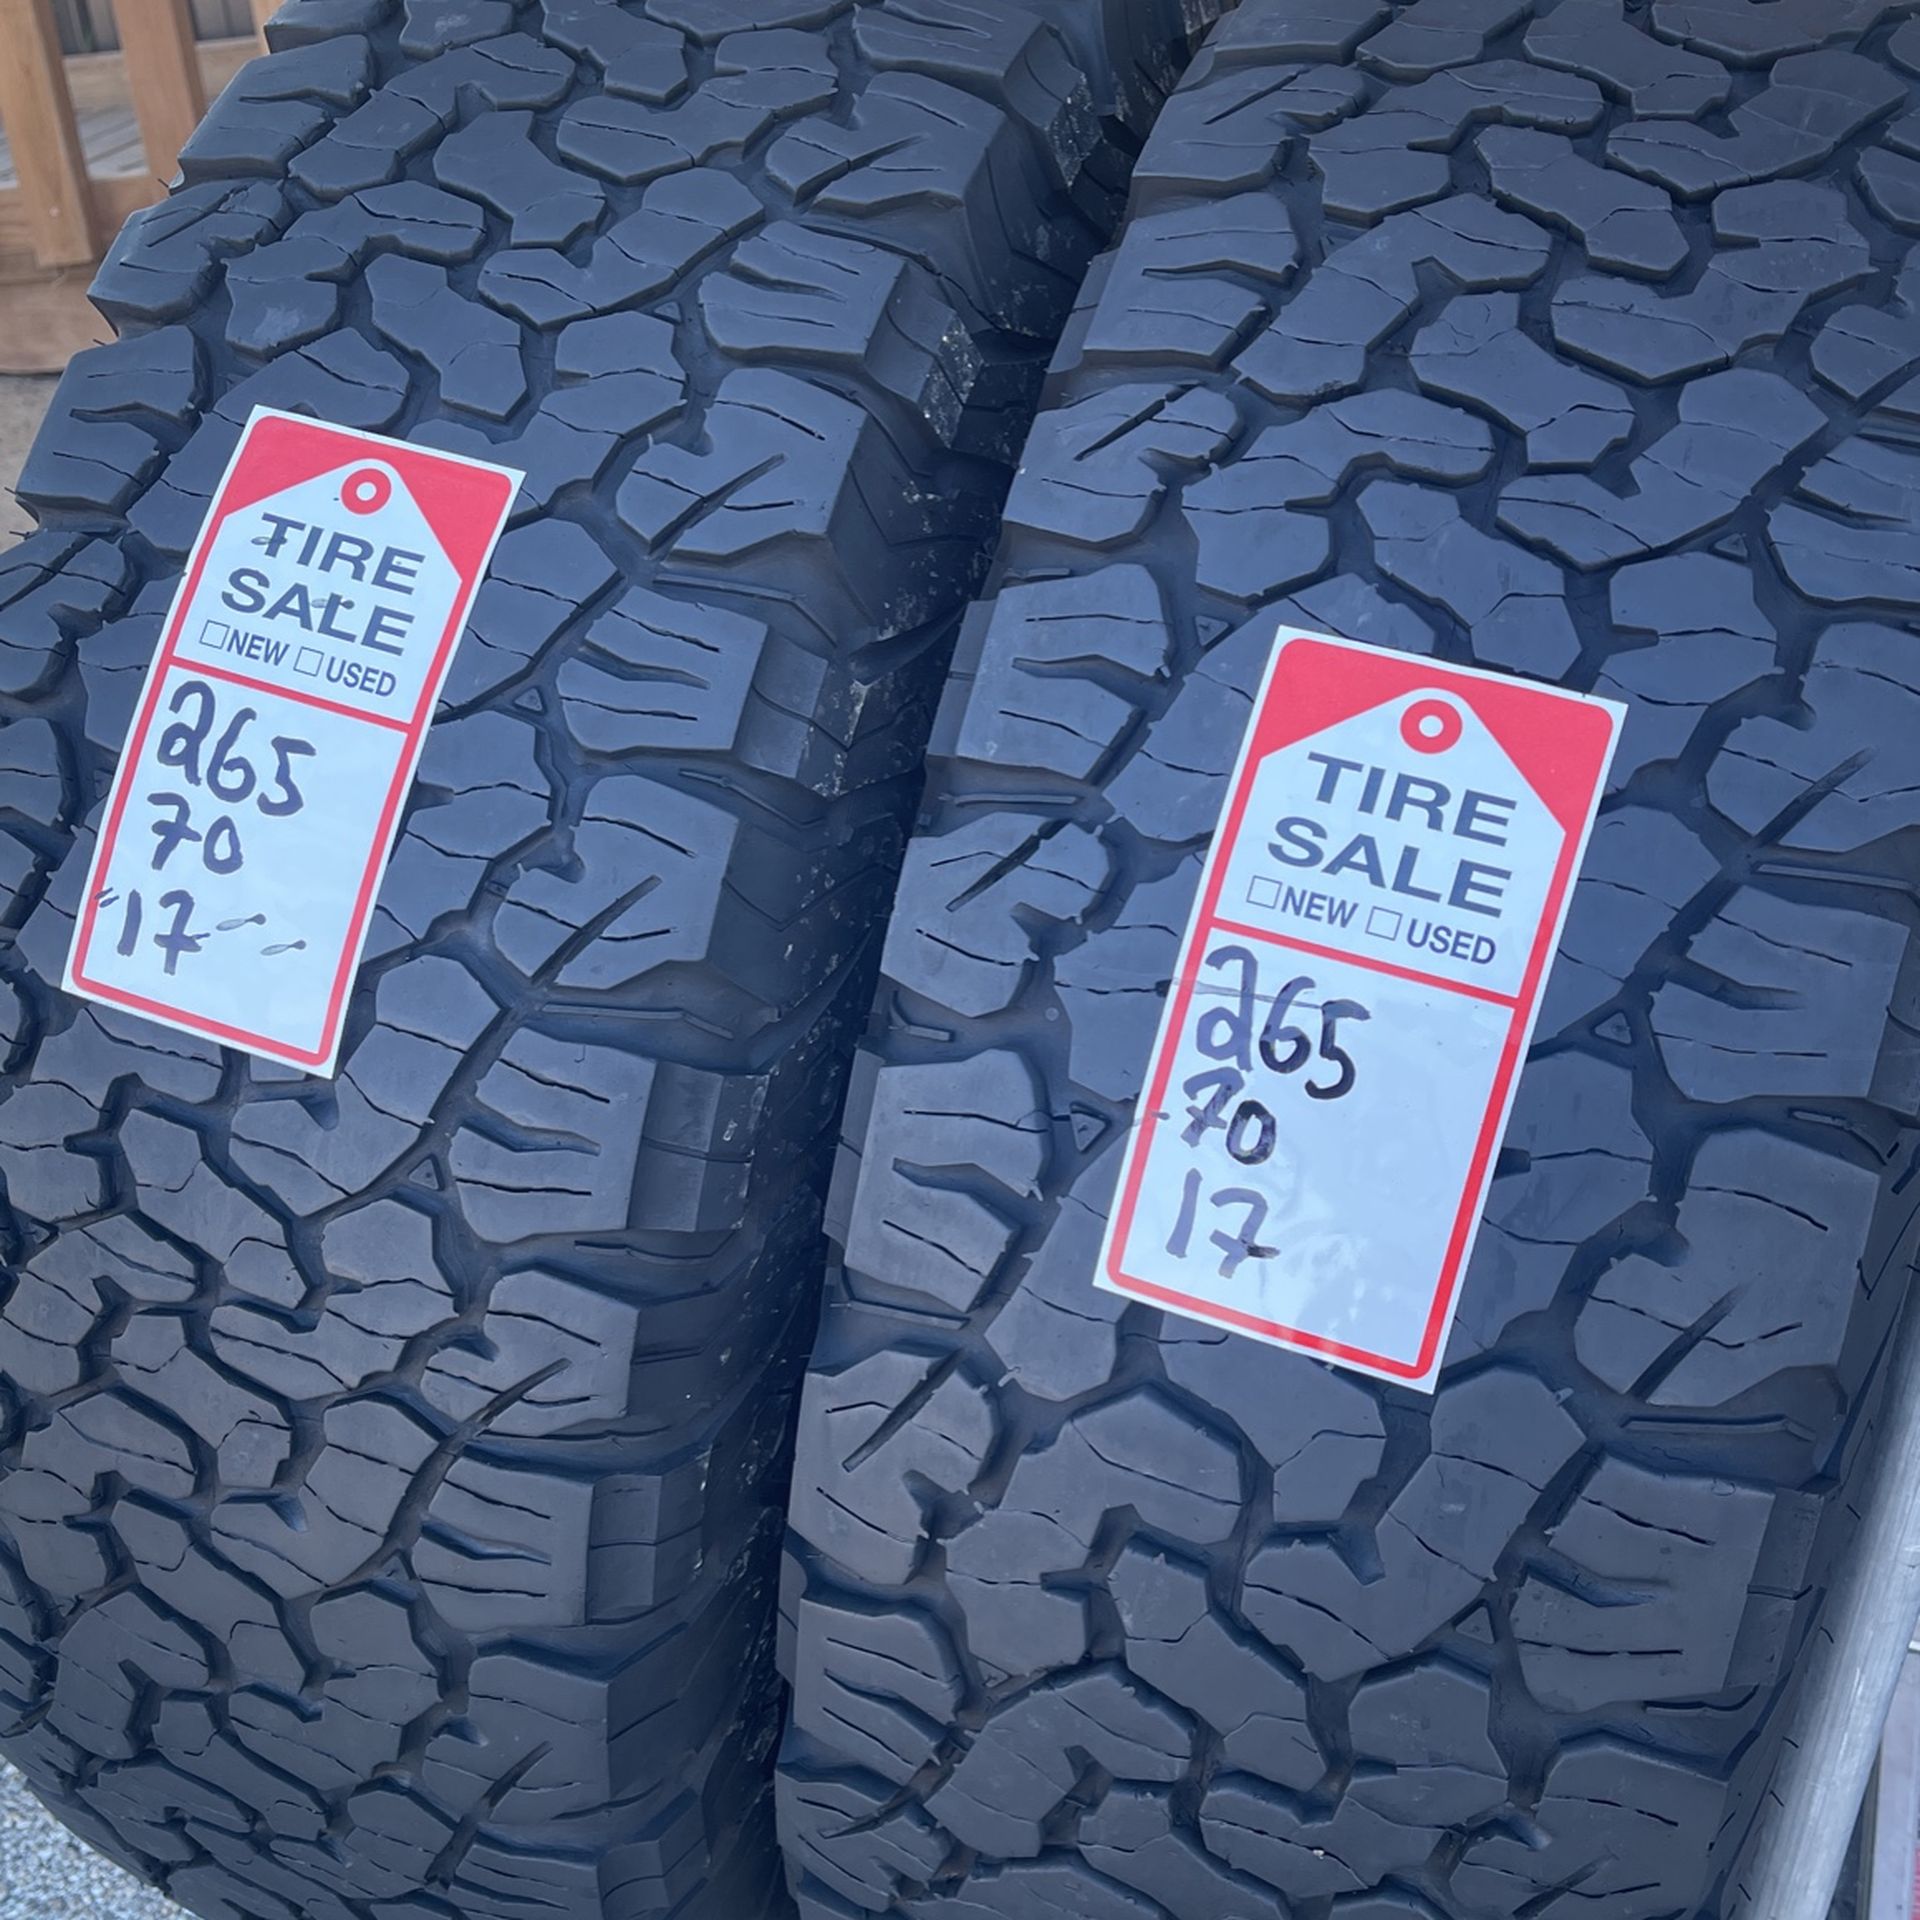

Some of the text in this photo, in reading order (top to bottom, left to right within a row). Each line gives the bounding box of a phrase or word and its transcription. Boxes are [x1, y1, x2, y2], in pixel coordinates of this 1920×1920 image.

[259, 511, 425, 596] TIRE
[221, 567, 413, 656] SALE
[227, 631, 397, 699] NEW USED
[157, 679, 317, 817] 265
[147, 791, 243, 875] 70
[1306, 751, 1517, 847] TIRE
[1268, 815, 1512, 919] SALE
[1281, 885, 1497, 967] NEW USED
[1196, 944, 1373, 1101] 265
[1181, 1067, 1276, 1165] 70
[1166, 1169, 1280, 1279] 17
